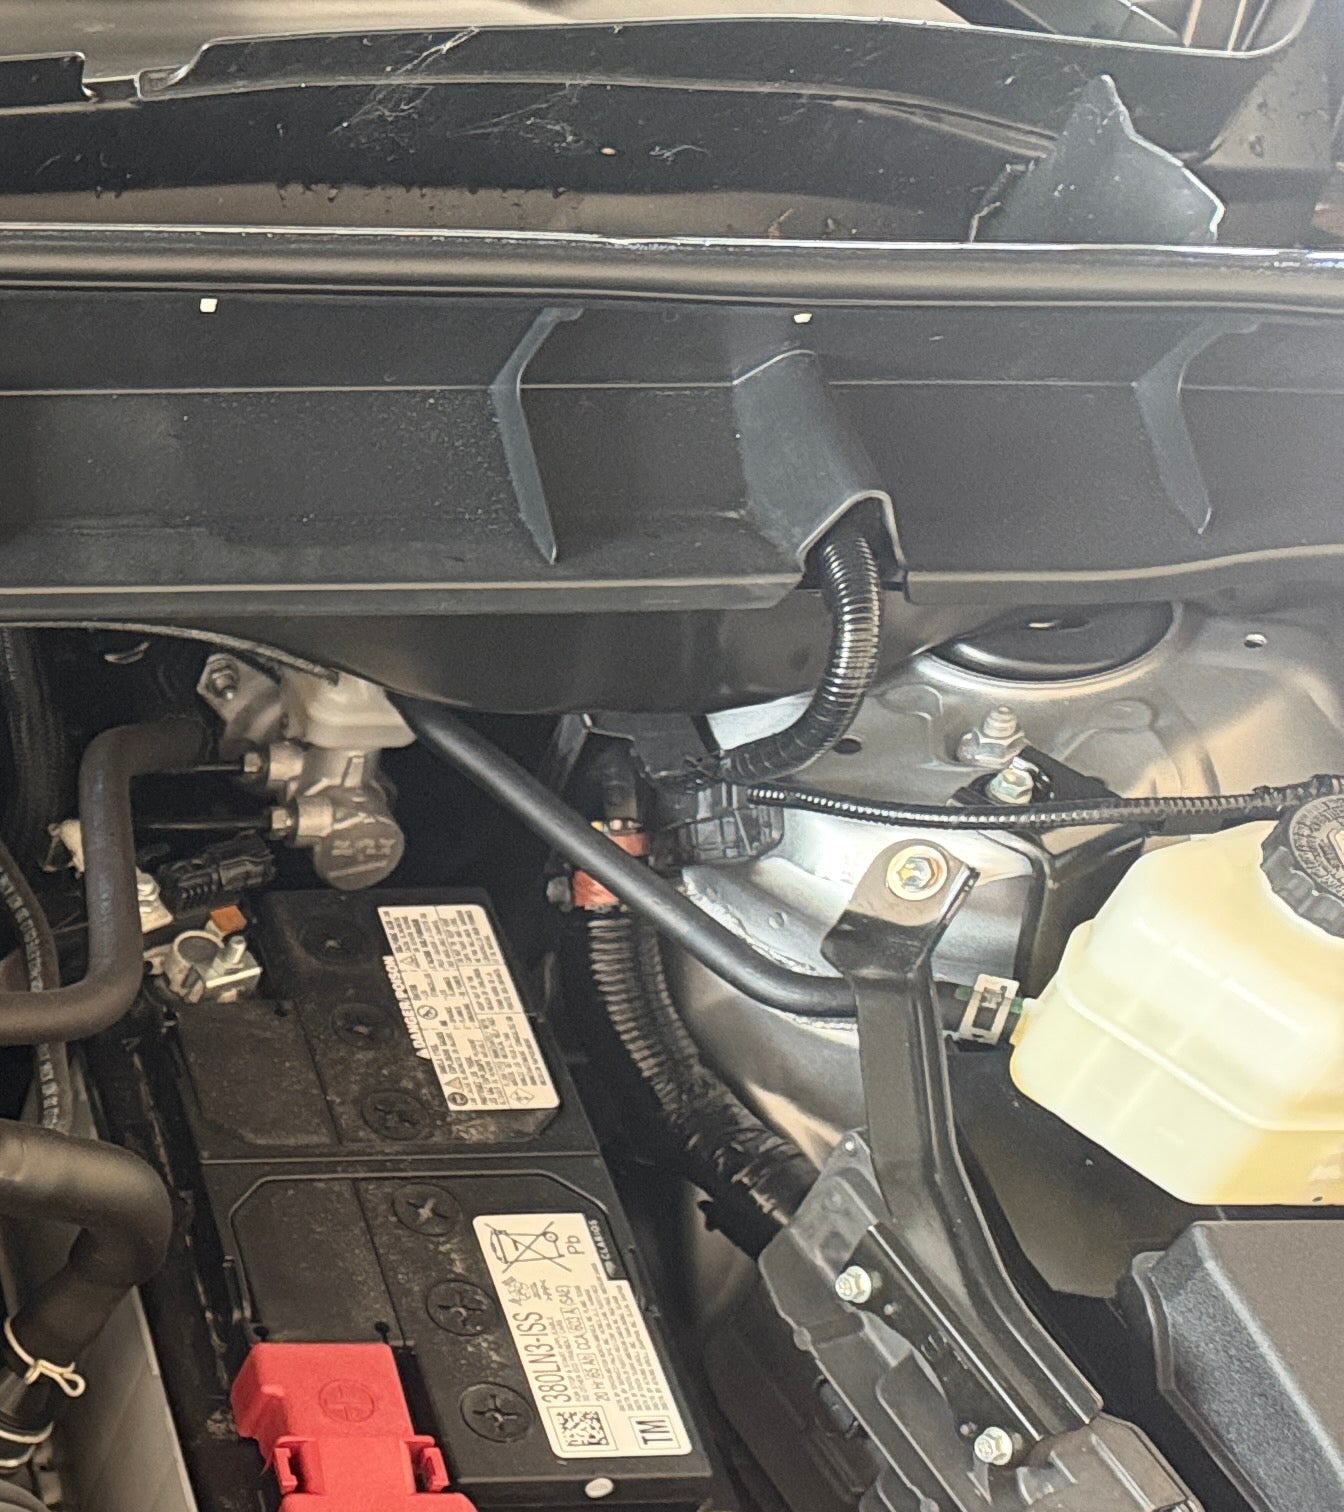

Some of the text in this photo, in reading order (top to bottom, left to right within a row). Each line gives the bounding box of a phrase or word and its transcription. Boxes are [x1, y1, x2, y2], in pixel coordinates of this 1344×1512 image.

[561, 1234, 585, 1254] Pb
[510, 1311, 572, 1402] 380LN3-ISS
[634, 1419, 674, 1445] TM
